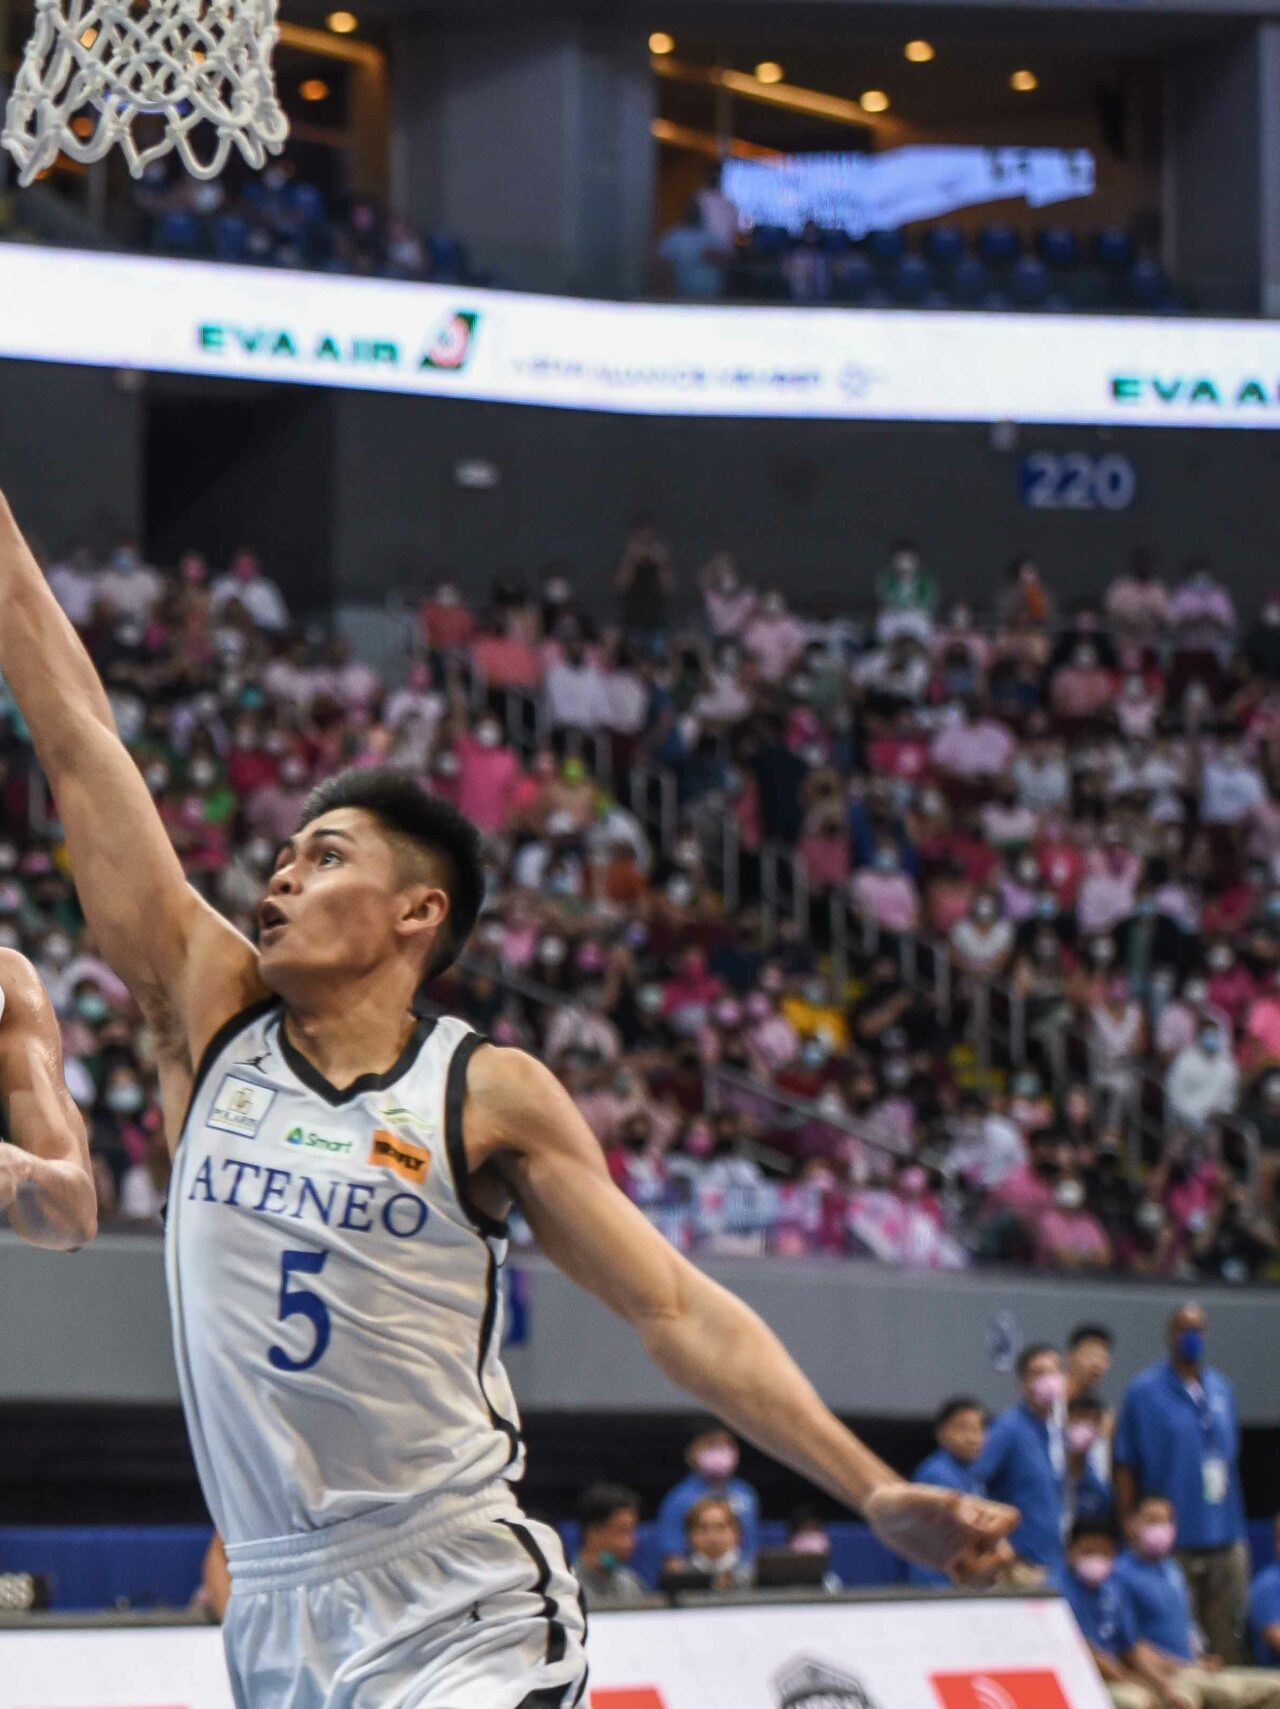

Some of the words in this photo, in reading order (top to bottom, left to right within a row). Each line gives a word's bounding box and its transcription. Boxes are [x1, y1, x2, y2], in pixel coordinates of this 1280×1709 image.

[199, 325, 297, 357] EVA
[1111, 376, 1218, 404] EVA
[1025, 452, 1136, 511] 220
[305, 1133, 354, 1154] Smart
[189, 1154, 429, 1238] ATENEO
[267, 1249, 331, 1372] 5
